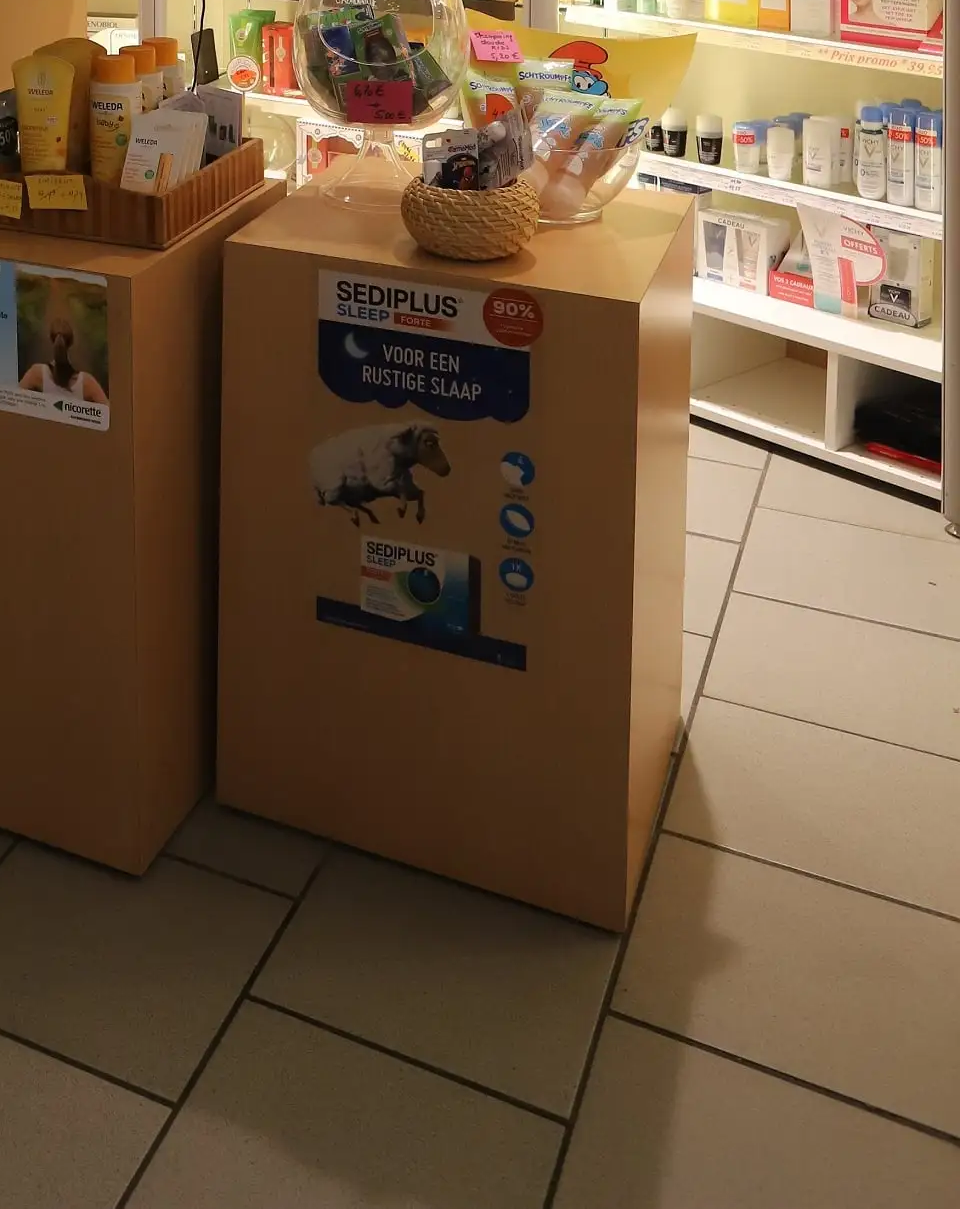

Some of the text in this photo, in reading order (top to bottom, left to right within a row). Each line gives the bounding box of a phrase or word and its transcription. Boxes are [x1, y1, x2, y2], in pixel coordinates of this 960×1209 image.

[830, 50, 898, 68] Prix promo
[92, 101, 124, 111] WELEDA
[735, 135, 754, 144] -50%
[862, 138, 879, 146] VICHY
[717, 217, 746, 230] CADEAU
[843, 225, 864, 236] VICHY
[843, 240, 879, 255] OFFERTS
[336, 280, 459, 318] SEDIPLUS
[336, 303, 433, 328] SLEEP FORTE
[492, 300, 535, 320] 90%
[874, 305, 911, 321] CADEAU
[382, 343, 460, 375] VOOR EEN
[362, 365, 482, 402] RUSTIGE SLAAP
[64, 403, 102, 418] nicorette
[366, 541, 436, 567] SEDIPLUS
[366, 555, 396, 568] SLEEP
